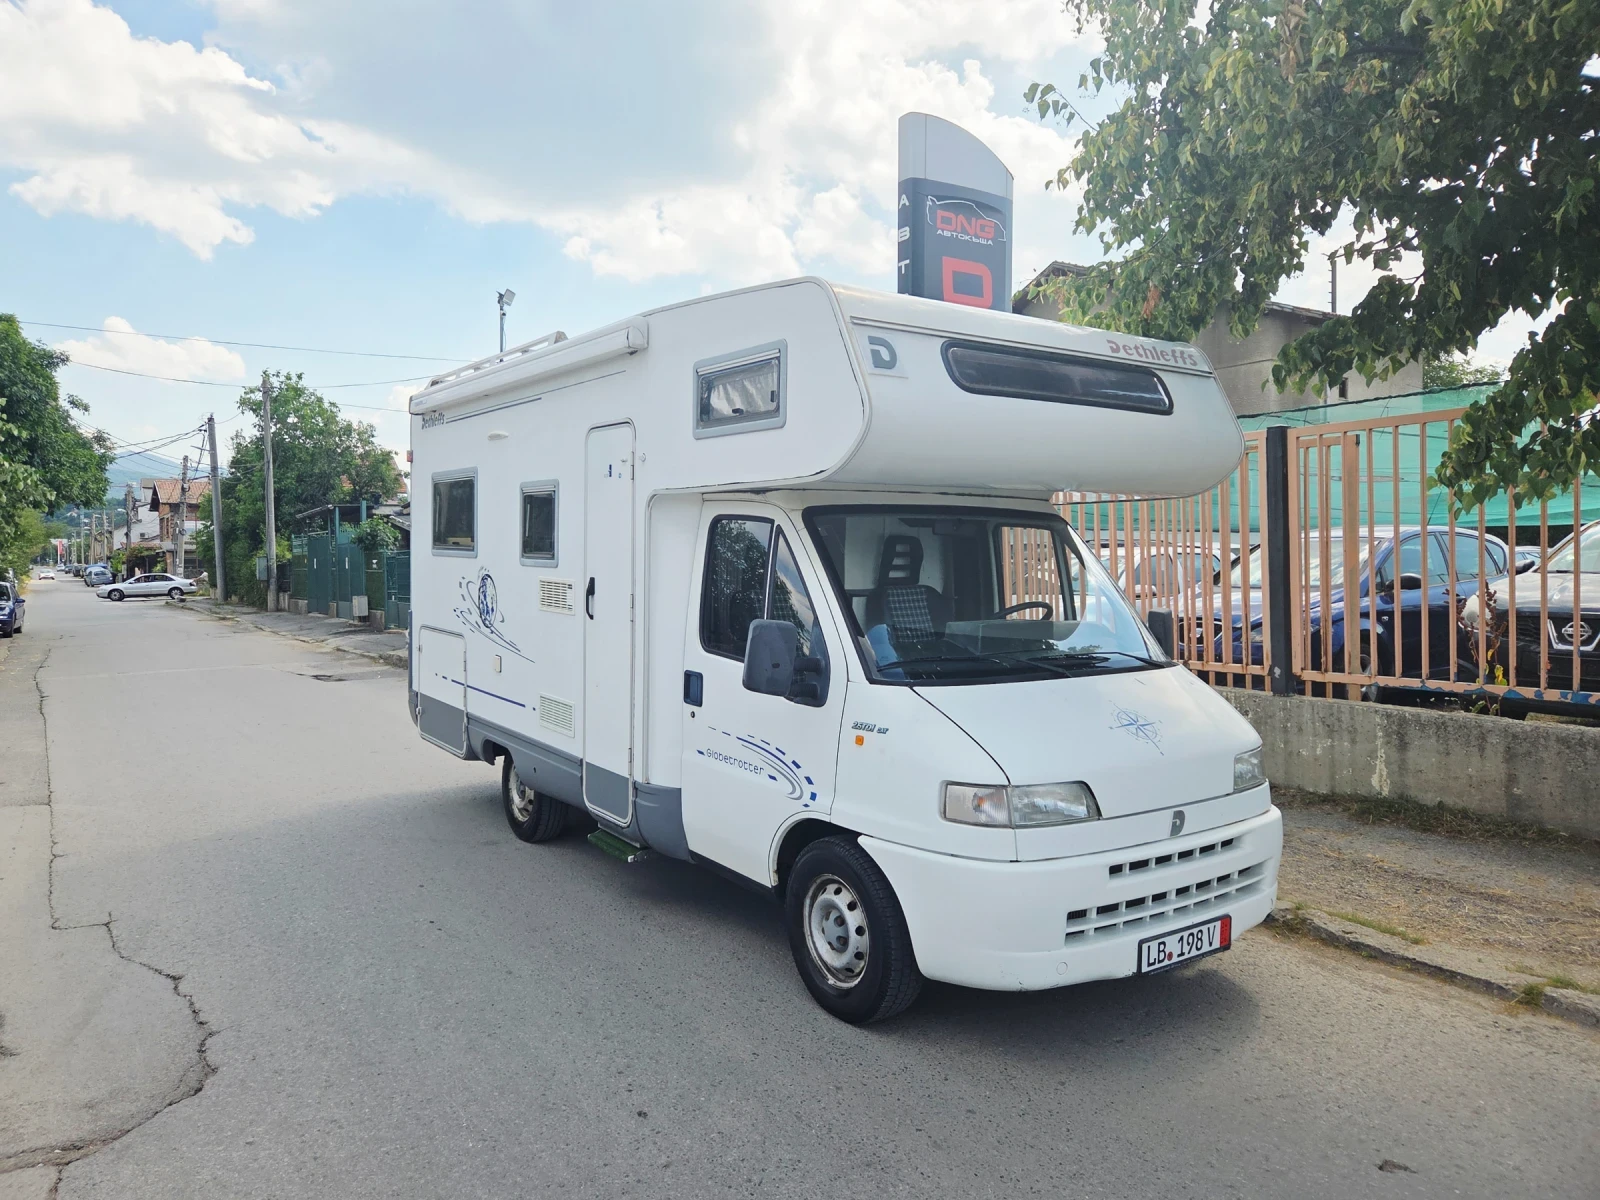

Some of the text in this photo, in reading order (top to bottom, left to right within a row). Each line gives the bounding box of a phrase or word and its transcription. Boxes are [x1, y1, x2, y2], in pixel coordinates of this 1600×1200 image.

[936, 209, 995, 239] DNG
[1106, 339, 1198, 367] Dethleffs
[706, 748, 765, 775] Globetrotter
[1146, 940, 1167, 968] LB
[1176, 928, 1204, 958] 198
[1207, 924, 1217, 948] V
